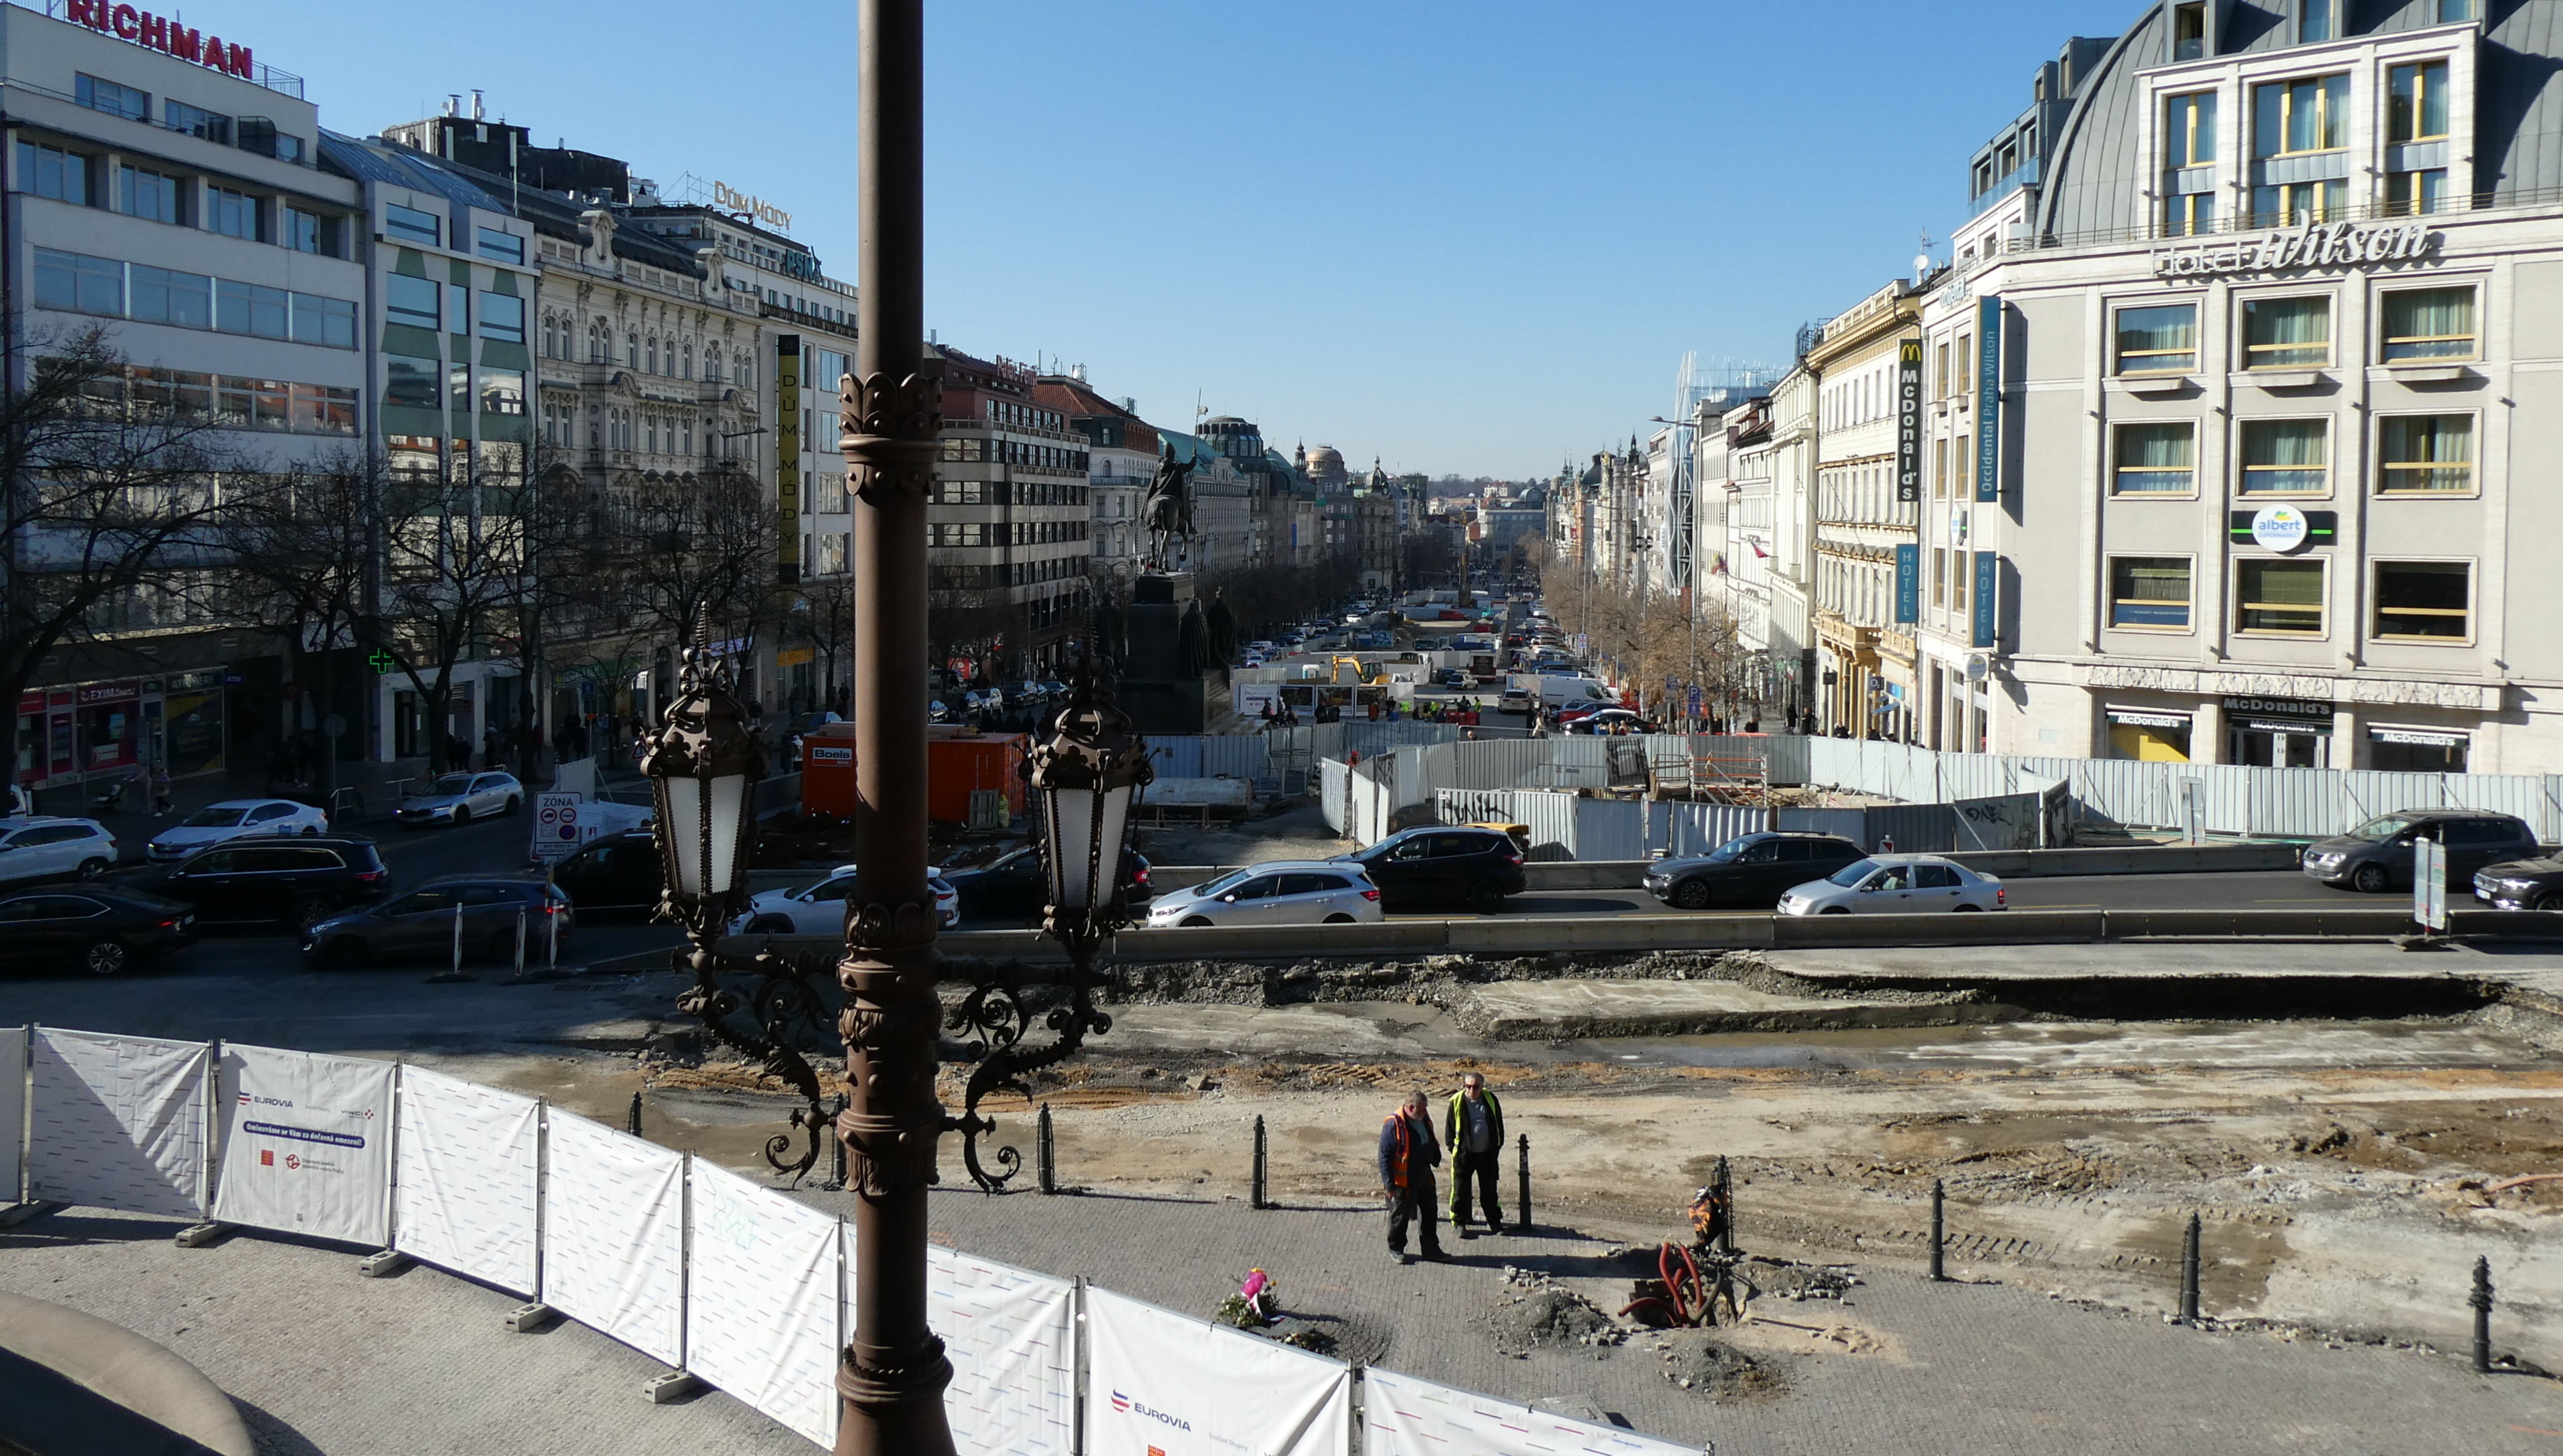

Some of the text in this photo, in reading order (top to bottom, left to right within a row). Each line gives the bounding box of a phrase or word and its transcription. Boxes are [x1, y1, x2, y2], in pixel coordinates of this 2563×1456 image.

[67, 0, 252, 79] RICHMAN
[2252, 208, 2428, 270] Wilson
[785, 248, 813, 280] PSN
[1981, 331, 1995, 492] Occidental Praha Wilson
[1901, 370, 1918, 500] McDonald's
[781, 375, 797, 543] DŮM MÓDY
[2258, 519, 2301, 531] albert
[1902, 551, 1911, 616] HOTEL
[1980, 561, 1989, 639] HOTEL
[1690, 688, 1698, 698] P
[2223, 698, 2330, 715] McDonald's
[2118, 715, 2179, 728] McDonald's
[2250, 720, 2315, 732] McDonald's
[2383, 733, 2455, 746] McDonald's
[815, 749, 850, 758] Boels
[544, 794, 574, 806] ZÓNA
[254, 1096, 294, 1108] EUROVIA
[246, 1123, 280, 1134] Omlouváme
[289, 1128, 302, 1138] Vám
[310, 1132, 334, 1142] dočasná
[1135, 1401, 1191, 1432] EUROVIA
